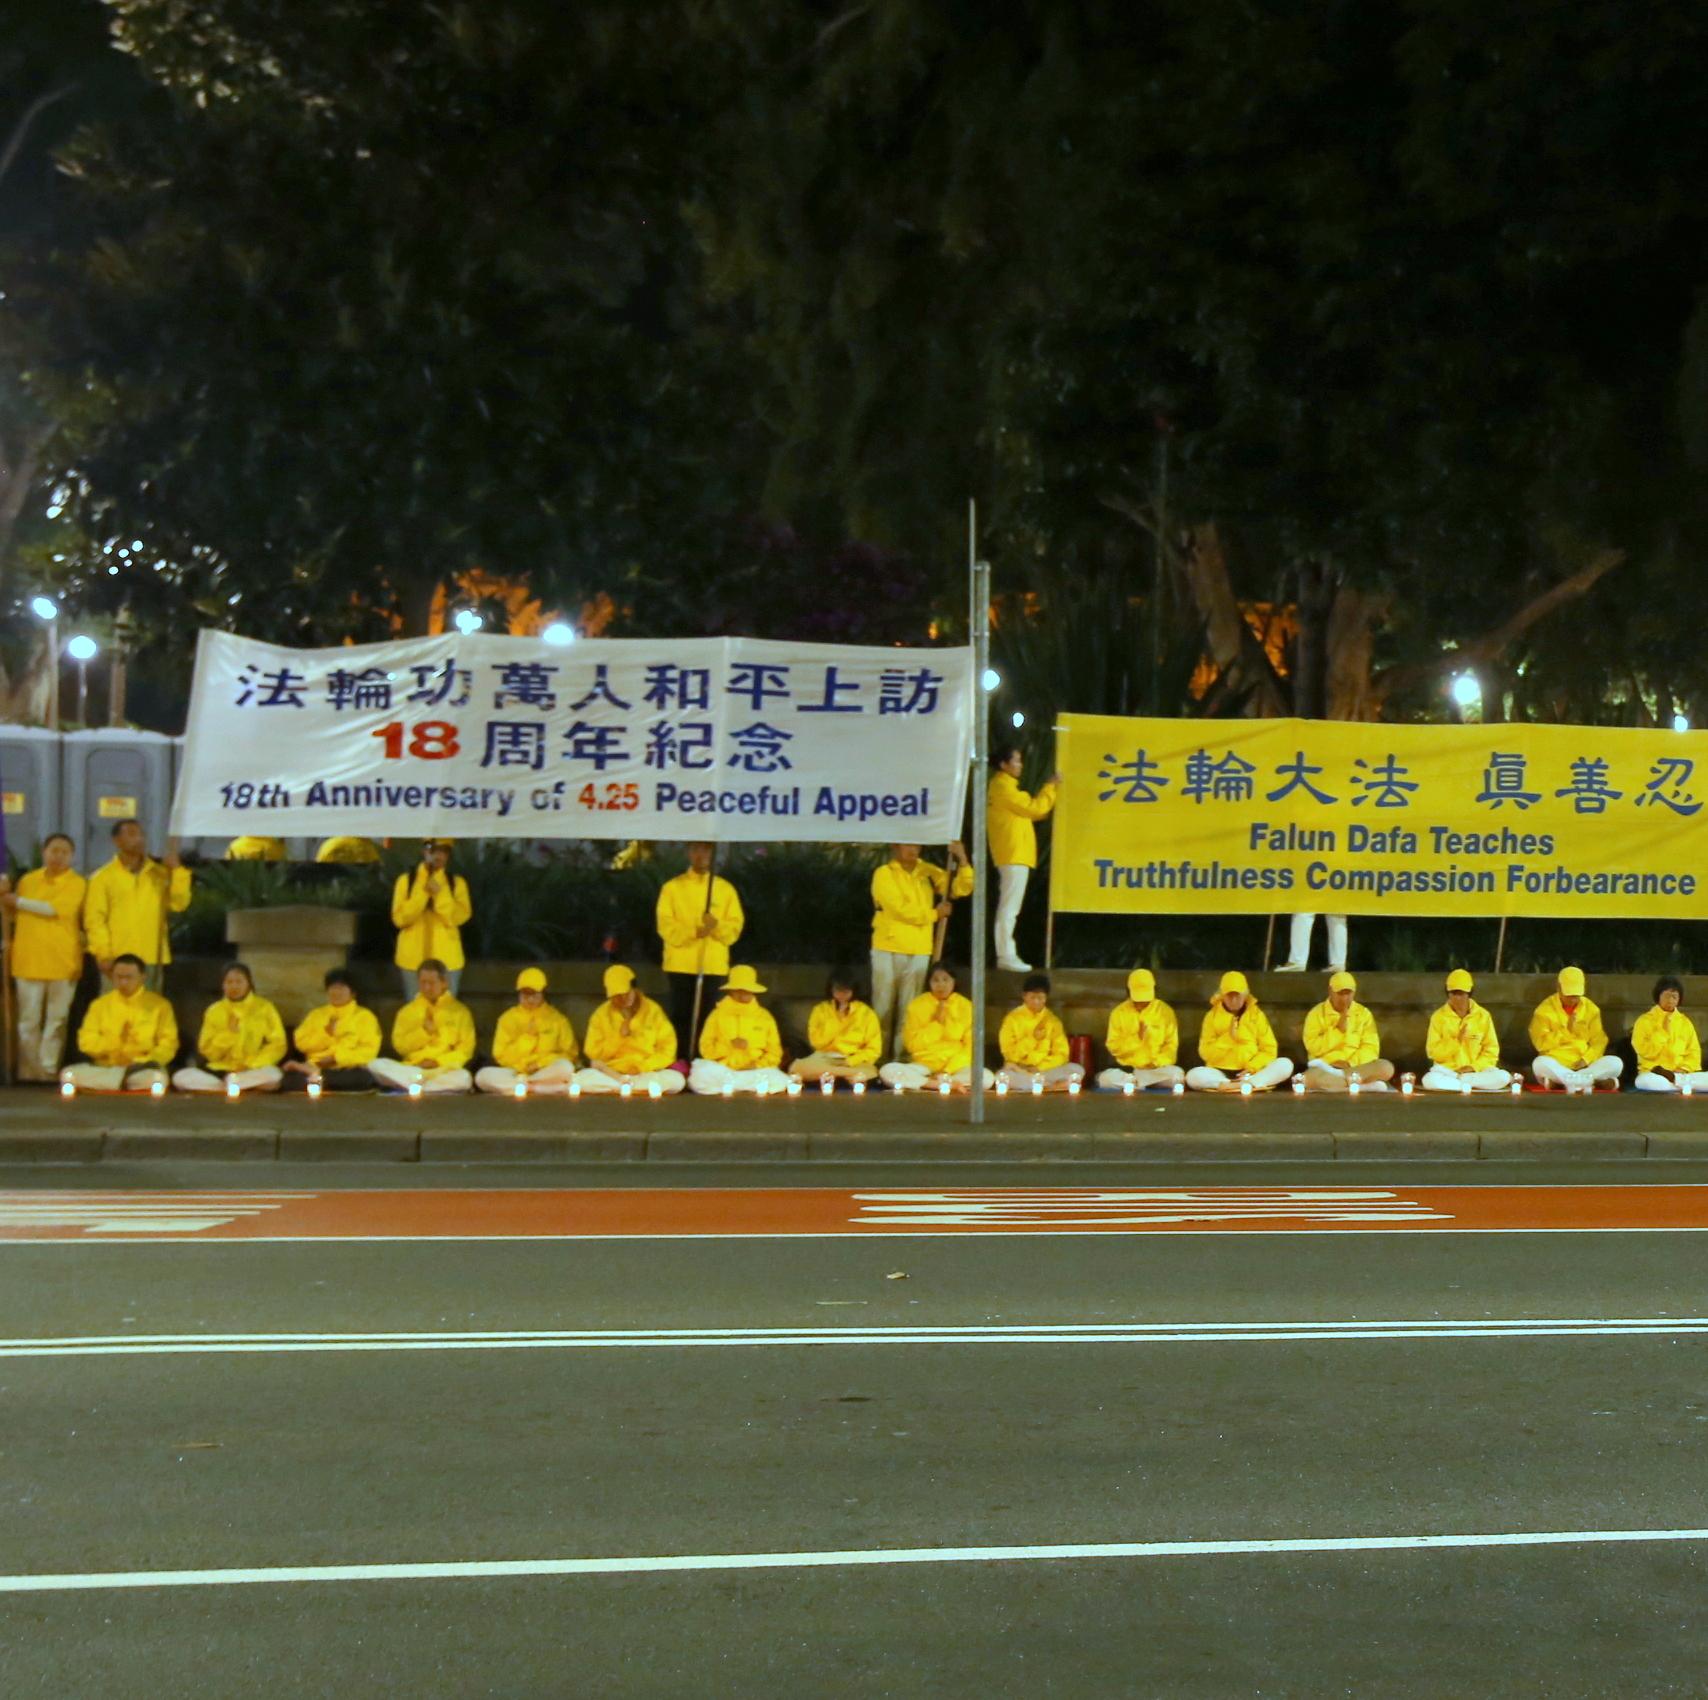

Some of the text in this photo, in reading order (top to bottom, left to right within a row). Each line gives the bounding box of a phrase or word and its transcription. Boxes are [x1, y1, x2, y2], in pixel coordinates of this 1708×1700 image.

[236, 659, 943, 714] 法輪功萬人和平上訪
[372, 720, 793, 772] 18周年紀念
[220, 778, 929, 821] 18th Anniversary of 4.25 Peaceful Appeal
[1098, 749, 1418, 807] 法輪大法
[1250, 823, 1555, 855] Falun Dafa Teaches
[1095, 859, 1696, 896] Truthfulness Compassion Forbearance
